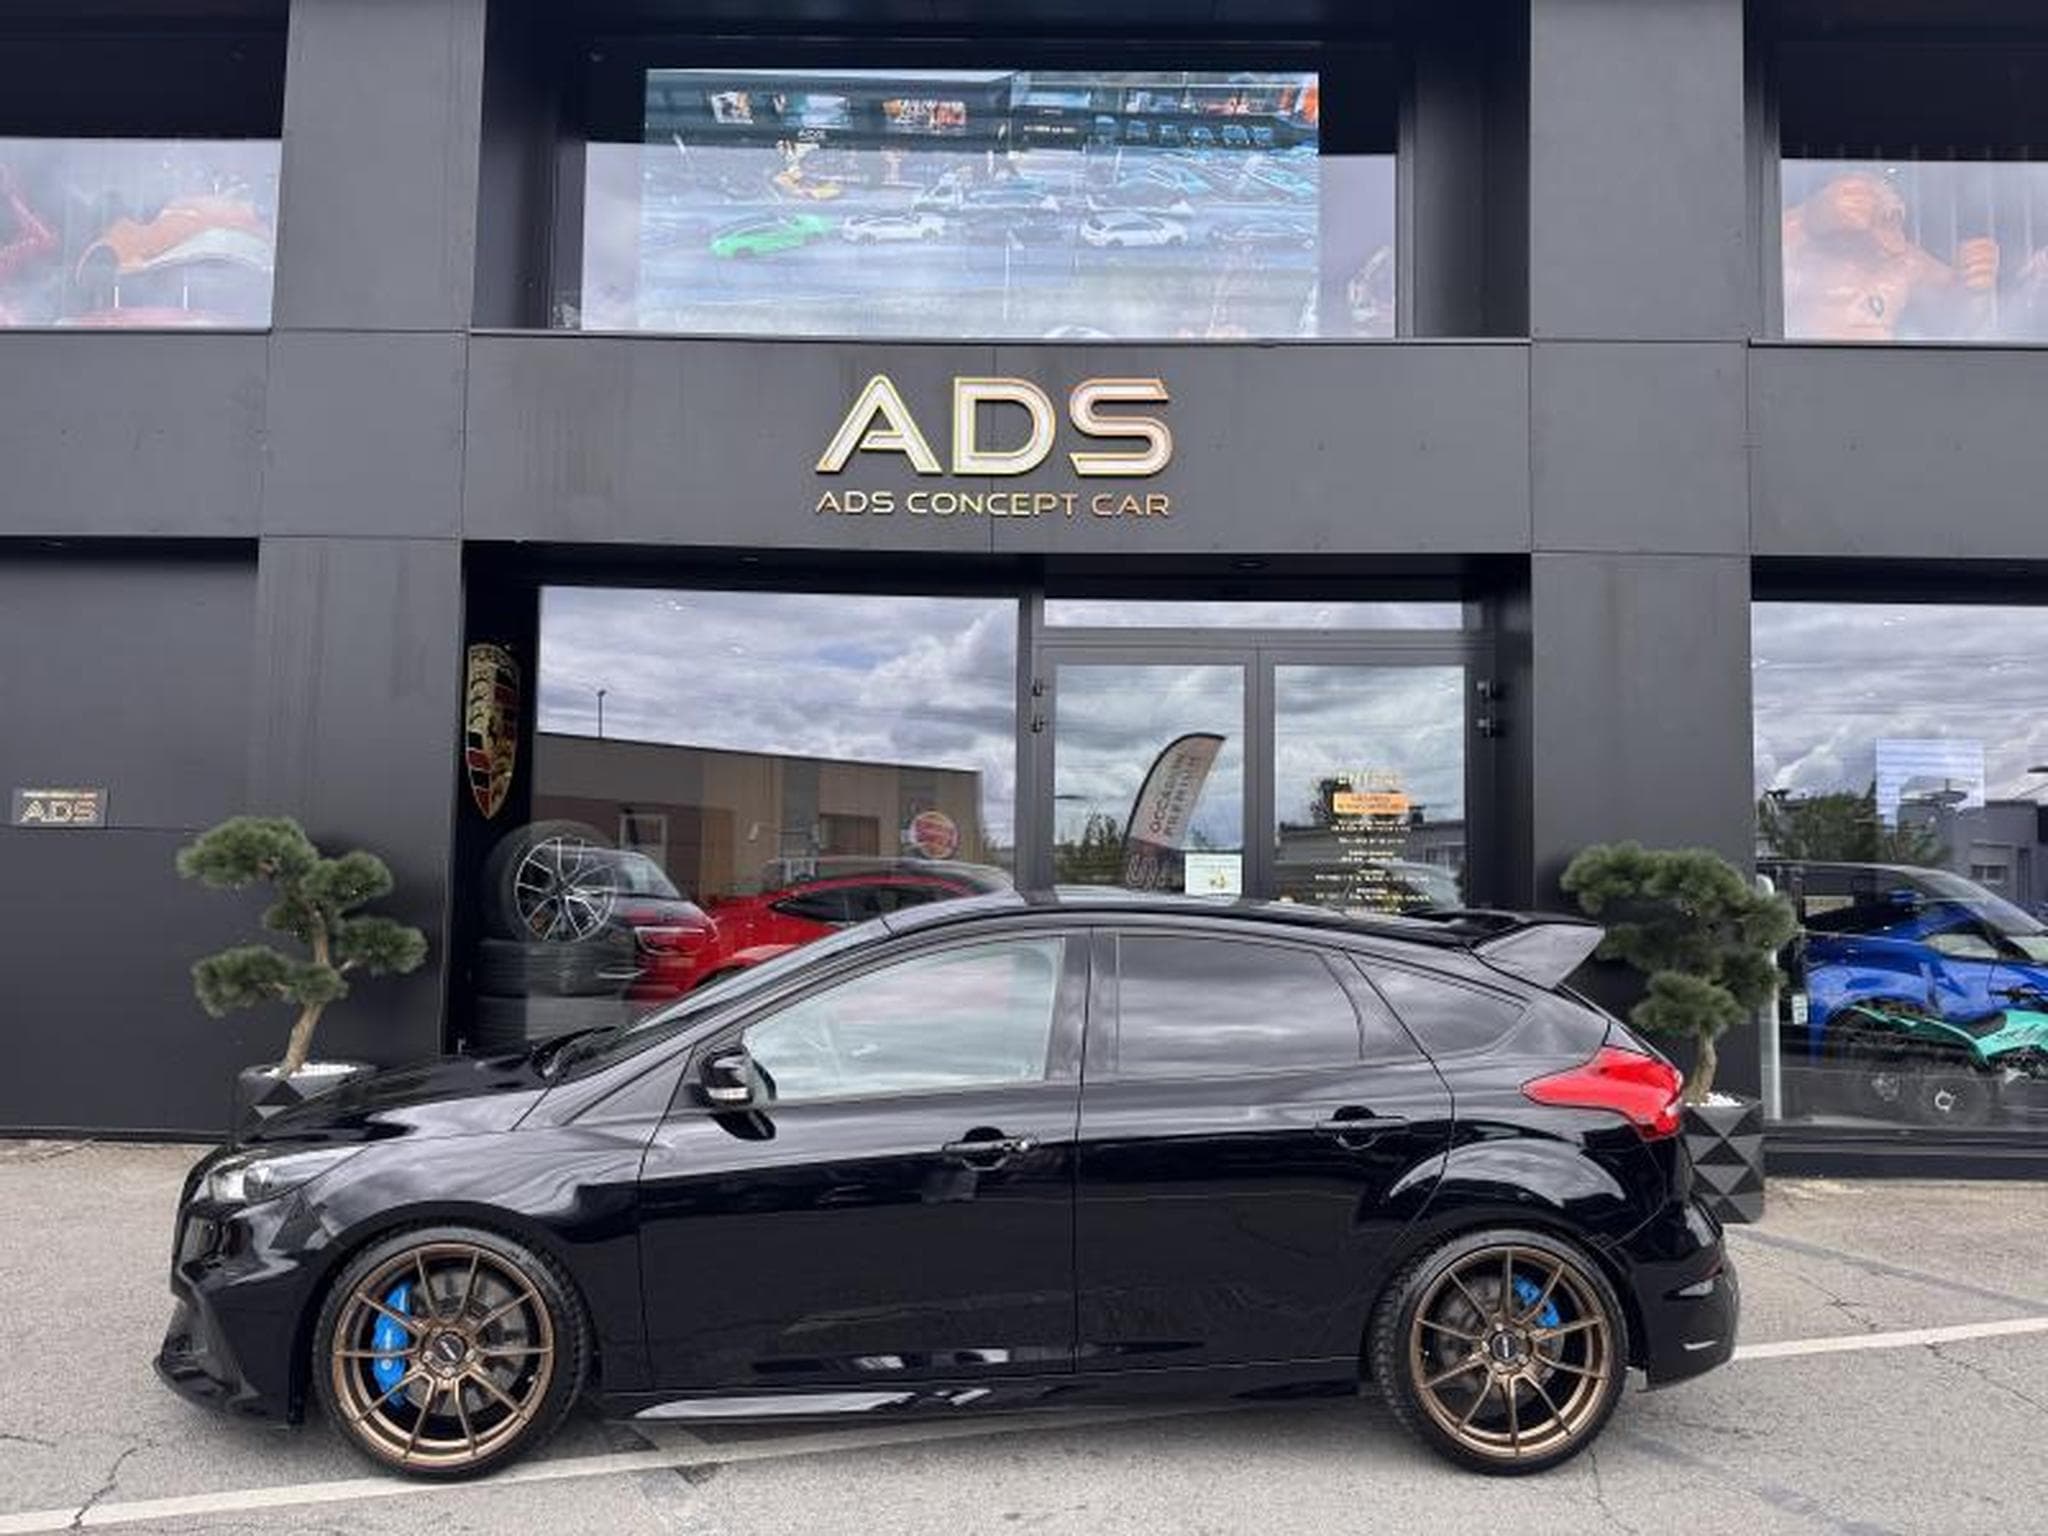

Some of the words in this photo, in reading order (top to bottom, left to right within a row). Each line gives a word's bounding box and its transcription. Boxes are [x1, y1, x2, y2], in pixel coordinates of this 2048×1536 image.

[815, 373, 1174, 476] ADS
[815, 491, 895, 515] ADS
[907, 493, 1078, 517] CONCEPT
[1092, 494, 1170, 517] CAR
[20, 800, 98, 823] ADS
